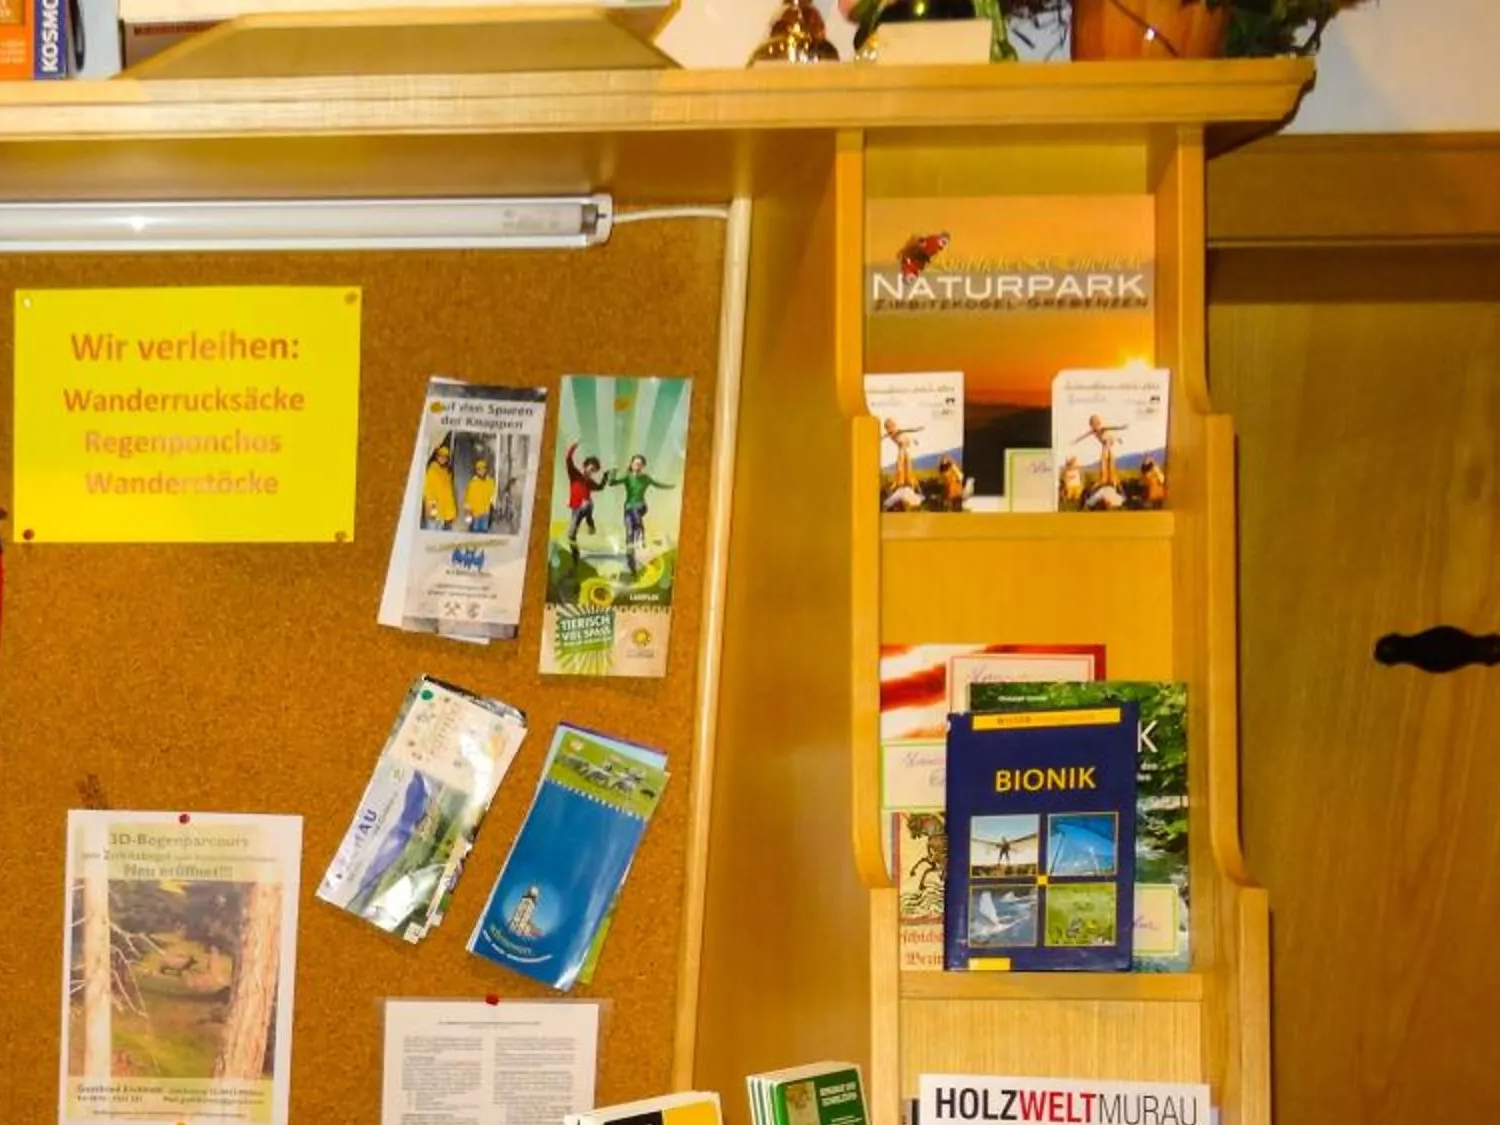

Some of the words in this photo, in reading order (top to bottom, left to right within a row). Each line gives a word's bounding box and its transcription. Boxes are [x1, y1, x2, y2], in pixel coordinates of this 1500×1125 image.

[873, 273, 1145, 300] NATURPARK
[71, 333, 128, 361] Wir
[138, 331, 299, 361] verleihen:
[64, 387, 305, 413] Wanderrucksäcke
[487, 403, 534, 418] Spuren
[466, 417, 523, 431] Knappen
[85, 429, 282, 458] Regenponchos
[85, 471, 279, 495] Wanderstöcke
[995, 766, 1096, 792] BIONIK
